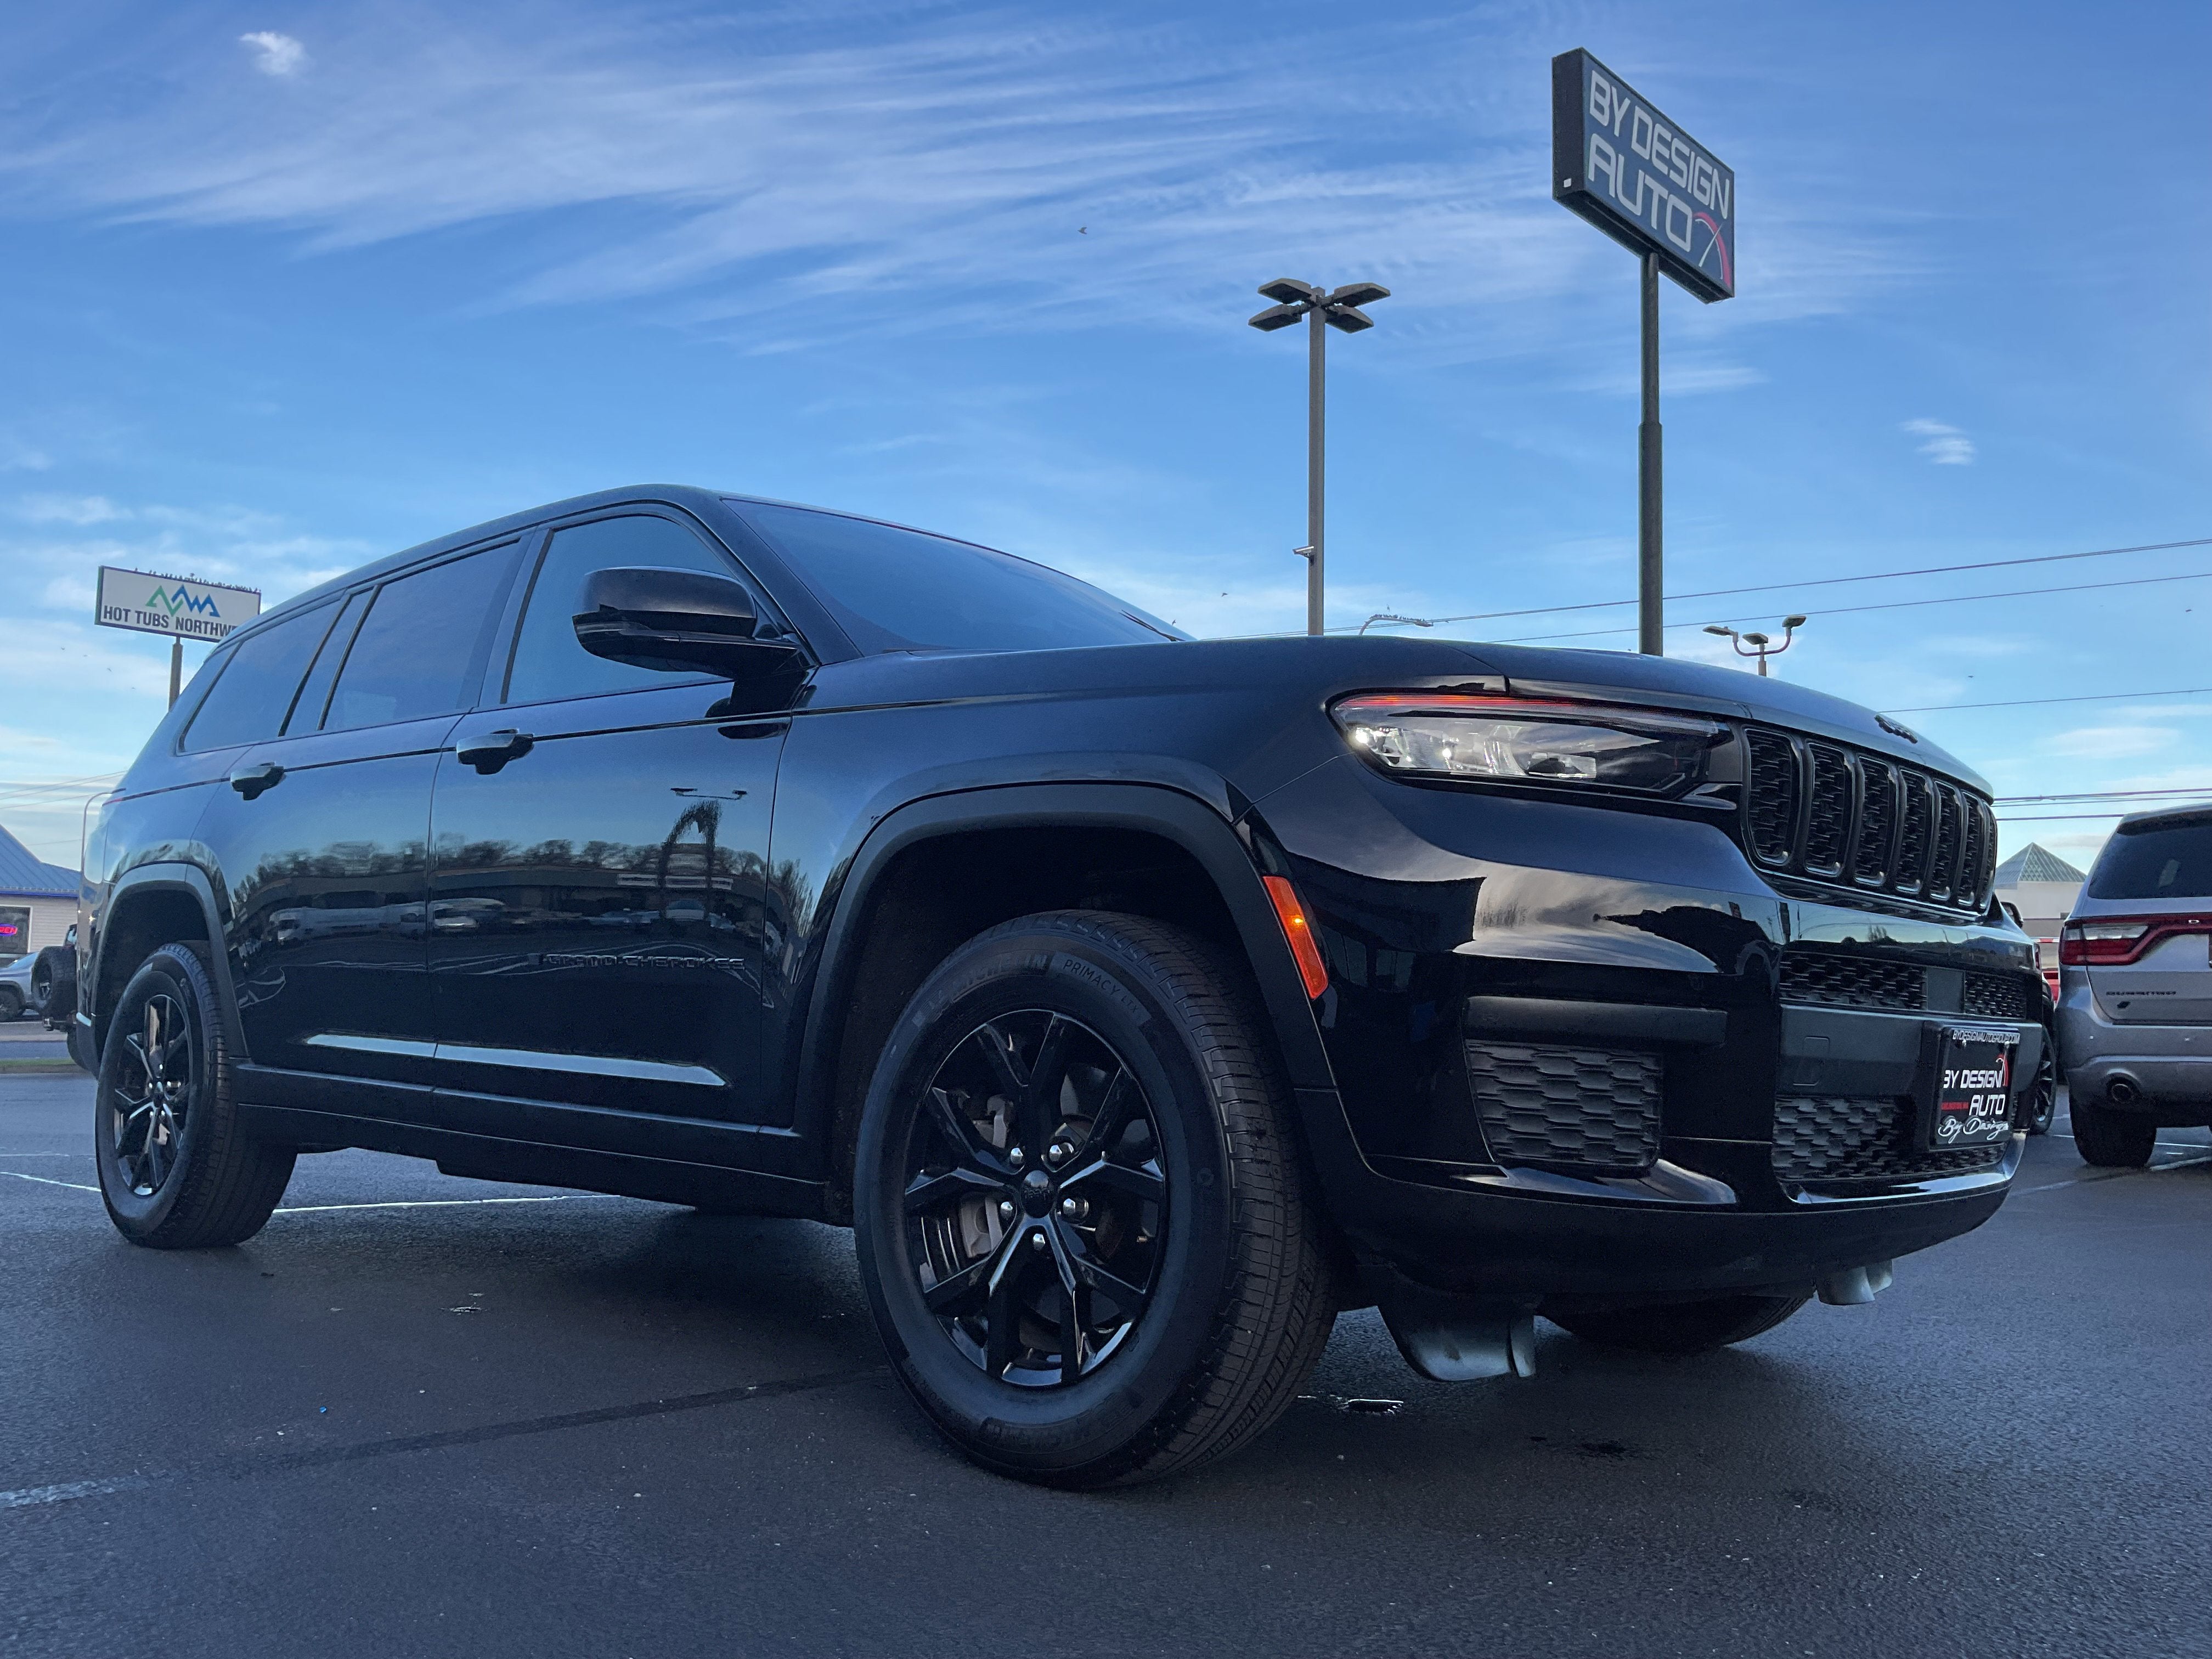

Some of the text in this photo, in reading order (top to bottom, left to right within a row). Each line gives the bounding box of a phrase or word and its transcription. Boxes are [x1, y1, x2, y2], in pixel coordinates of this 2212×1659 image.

[1589, 70, 1730, 219] BY DESIGN
[1588, 133, 1692, 252] AUTO
[103, 605, 131, 622] HOT
[134, 610, 170, 628] TUBS
[622, 955, 745, 970] CHEROKEE
[1062, 959, 1139, 1014] PRIMACY LTX
[1953, 1030, 2020, 1044] BYDESIGNAUTOGROUPCOM
[1943, 1069, 2004, 1088] BY DESIGN
[1968, 1094, 2006, 1116] AUTO
[1938, 1118, 1963, 1144] By
